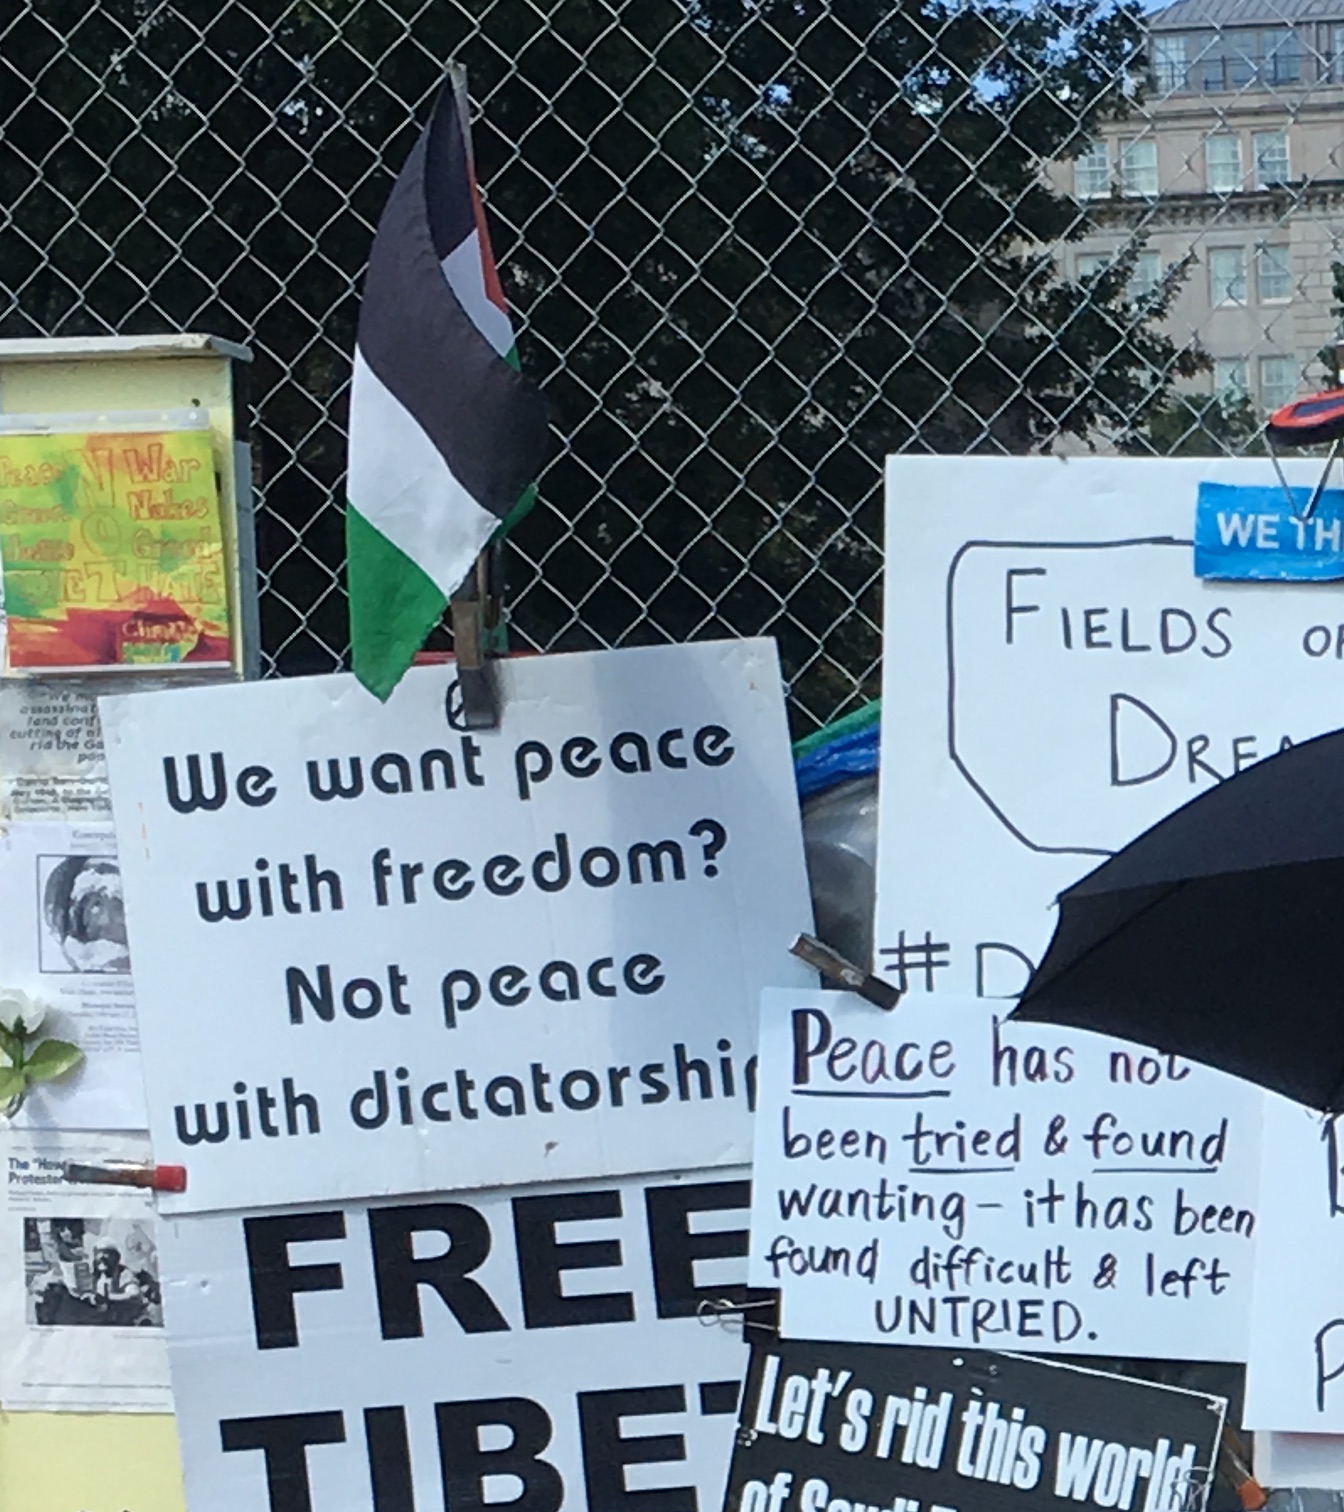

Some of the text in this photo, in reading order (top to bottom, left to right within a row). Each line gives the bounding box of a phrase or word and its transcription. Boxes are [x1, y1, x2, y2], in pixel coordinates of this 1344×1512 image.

[1216, 512, 1280, 549] WE
[1004, 567, 1234, 659] FIELDS
[163, 752, 278, 814] We
[307, 735, 485, 803] want
[515, 724, 735, 800] peace
[195, 818, 727, 923] with freedom?
[286, 953, 666, 1029] Not peace
[791, 1008, 1191, 1088] Peace has not
[174, 1078, 321, 1146] with
[783, 1106, 1230, 1167] been tried & found
[1174, 1189, 1257, 1239] been
[242, 1180, 752, 1351] FREE
[764, 1236, 1232, 1297] found difficult & left
[875, 1296, 1100, 1344] UNTRIED.
[755, 1353, 873, 1455] Let's
[876, 1386, 954, 1471] rid
[956, 1397, 1046, 1492] this
